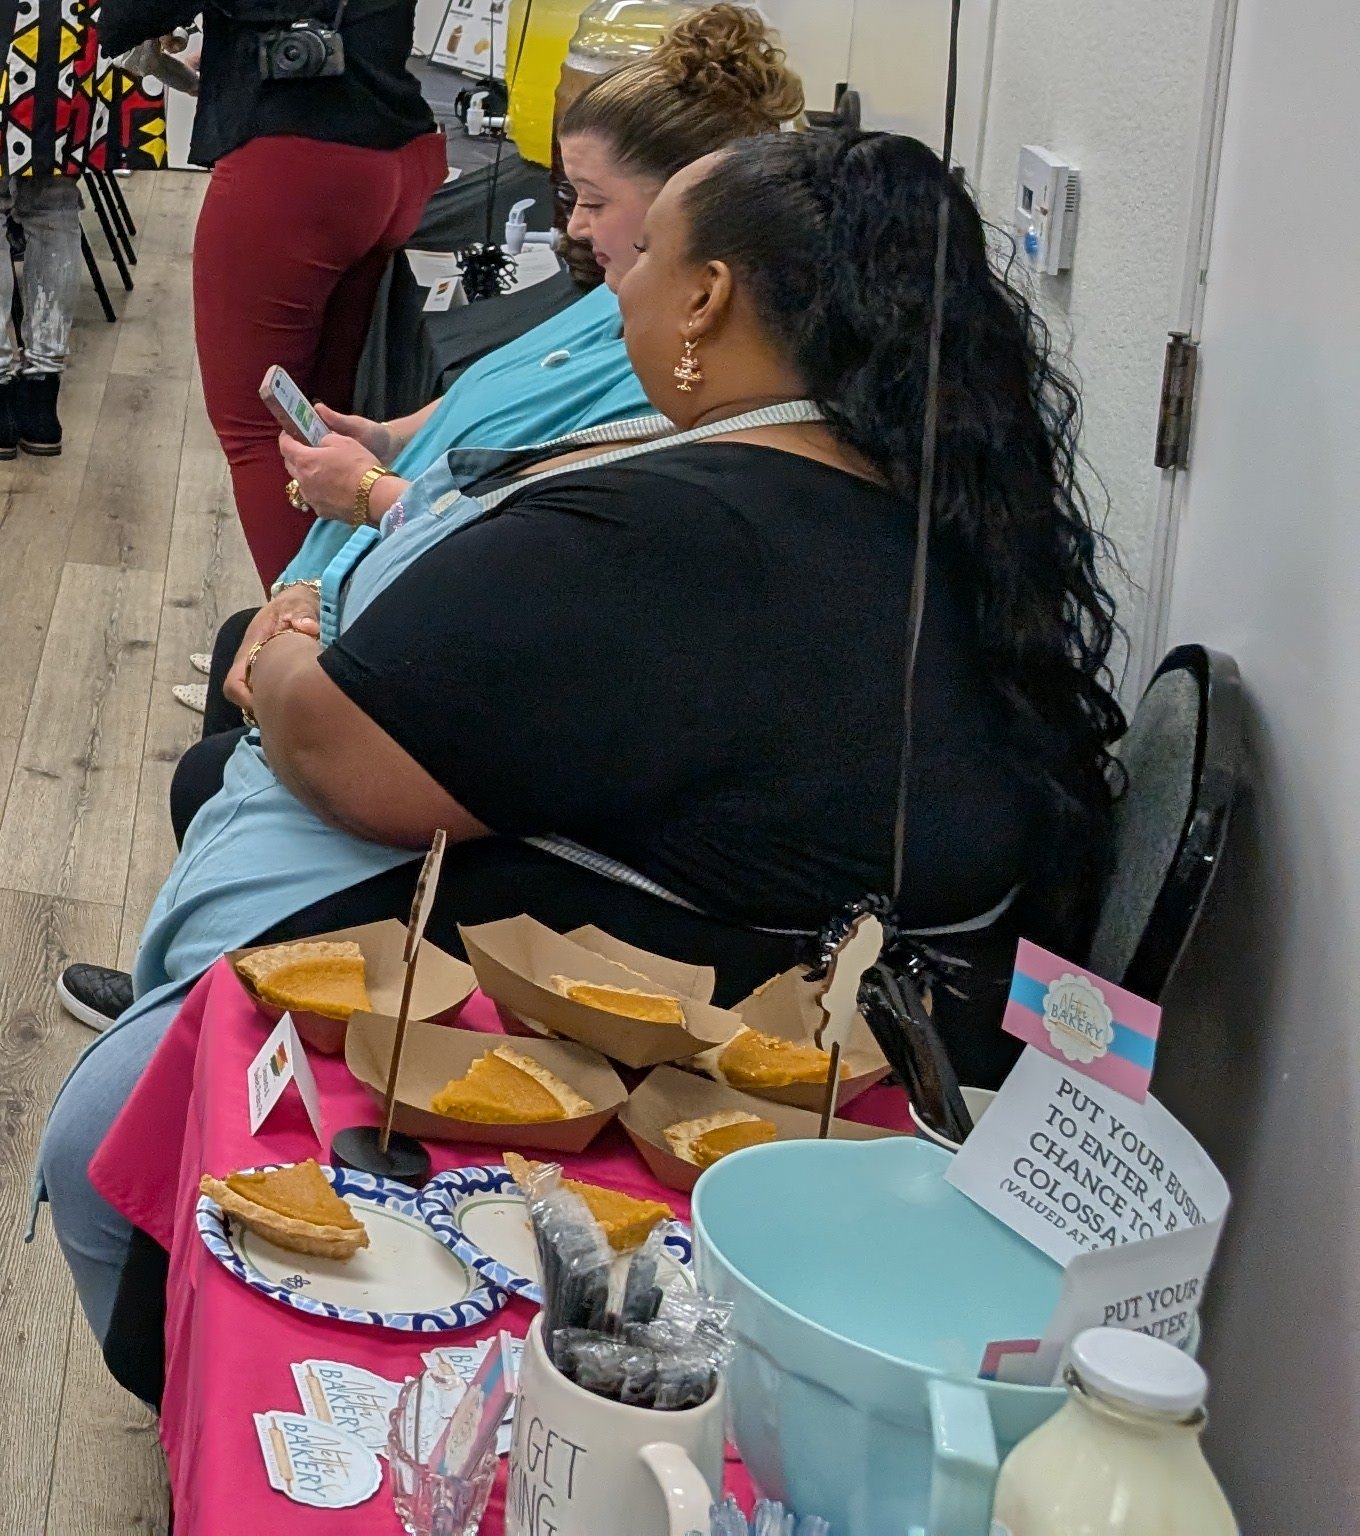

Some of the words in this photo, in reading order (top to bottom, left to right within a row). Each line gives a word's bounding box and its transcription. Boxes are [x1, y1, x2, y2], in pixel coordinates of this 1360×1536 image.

[1050, 1003, 1104, 1041] BAKERY
[1029, 1131, 1128, 1215] CHANCE
[1128, 1207, 1155, 1240] TO
[1045, 1103, 1078, 1138] TO
[1078, 1132, 1149, 1202] ENTER
[1147, 1196, 1163, 1222] A
[1056, 1077, 1104, 1124] PUT
[1107, 1114, 1165, 1183] YOUR
[1167, 1171, 1208, 1225] BUSIN
[999, 1177, 1066, 1231] (VALUED
[1066, 1226, 1089, 1245] AT
[1103, 1295, 1143, 1327] PUT
[1146, 1277, 1200, 1313] YOUR
[318, 1367, 366, 1439] BAKERY
[283, 1421, 327, 1498] BAKERY
[527, 1417, 588, 1500] GET
